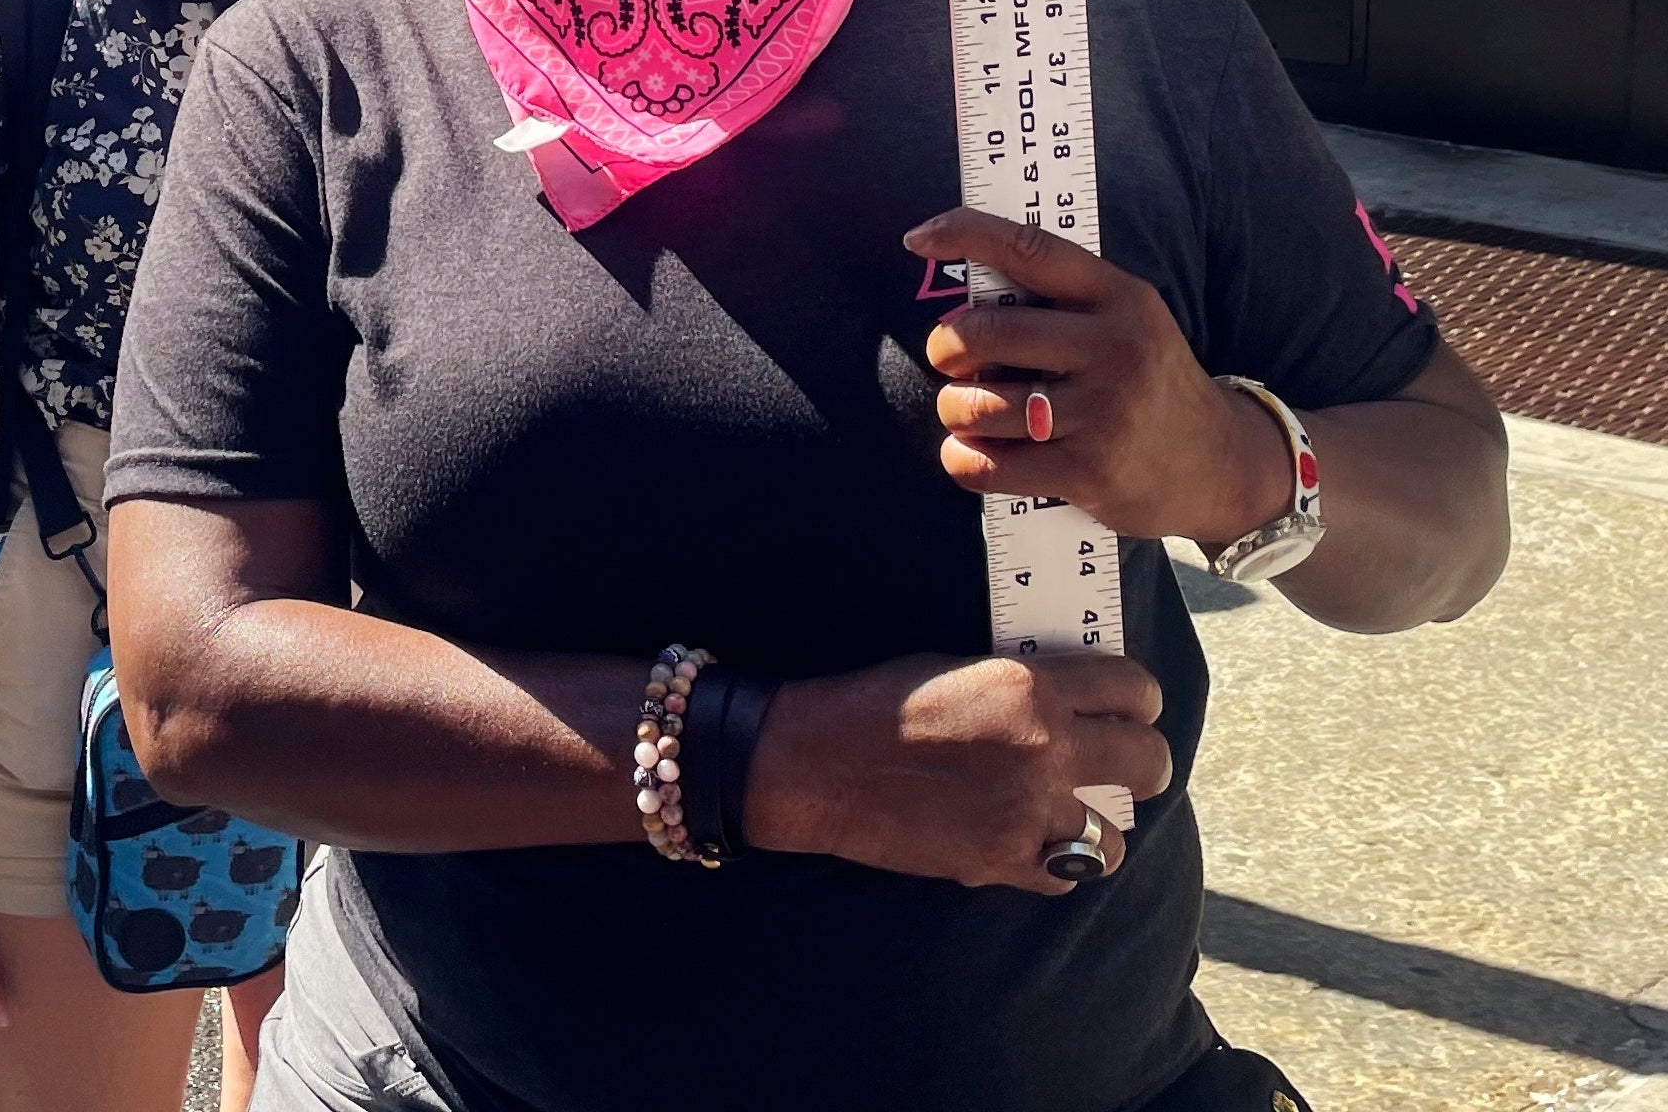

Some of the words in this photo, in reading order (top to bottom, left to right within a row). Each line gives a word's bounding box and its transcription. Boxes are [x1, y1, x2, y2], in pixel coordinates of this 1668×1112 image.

[983, 63, 1000, 94] 11
[1049, 52, 1067, 86] 37
[1019, 70, 1037, 154] TOOL
[987, 130, 1005, 164] 10
[1052, 122, 1071, 158] 38
[1024, 161, 1039, 182] &
[1057, 192, 1075, 228] 39
[1011, 500, 1028, 515] 5
[1078, 540, 1095, 576] 44
[1015, 571, 1032, 586] 4
[1082, 610, 1100, 645] 45
